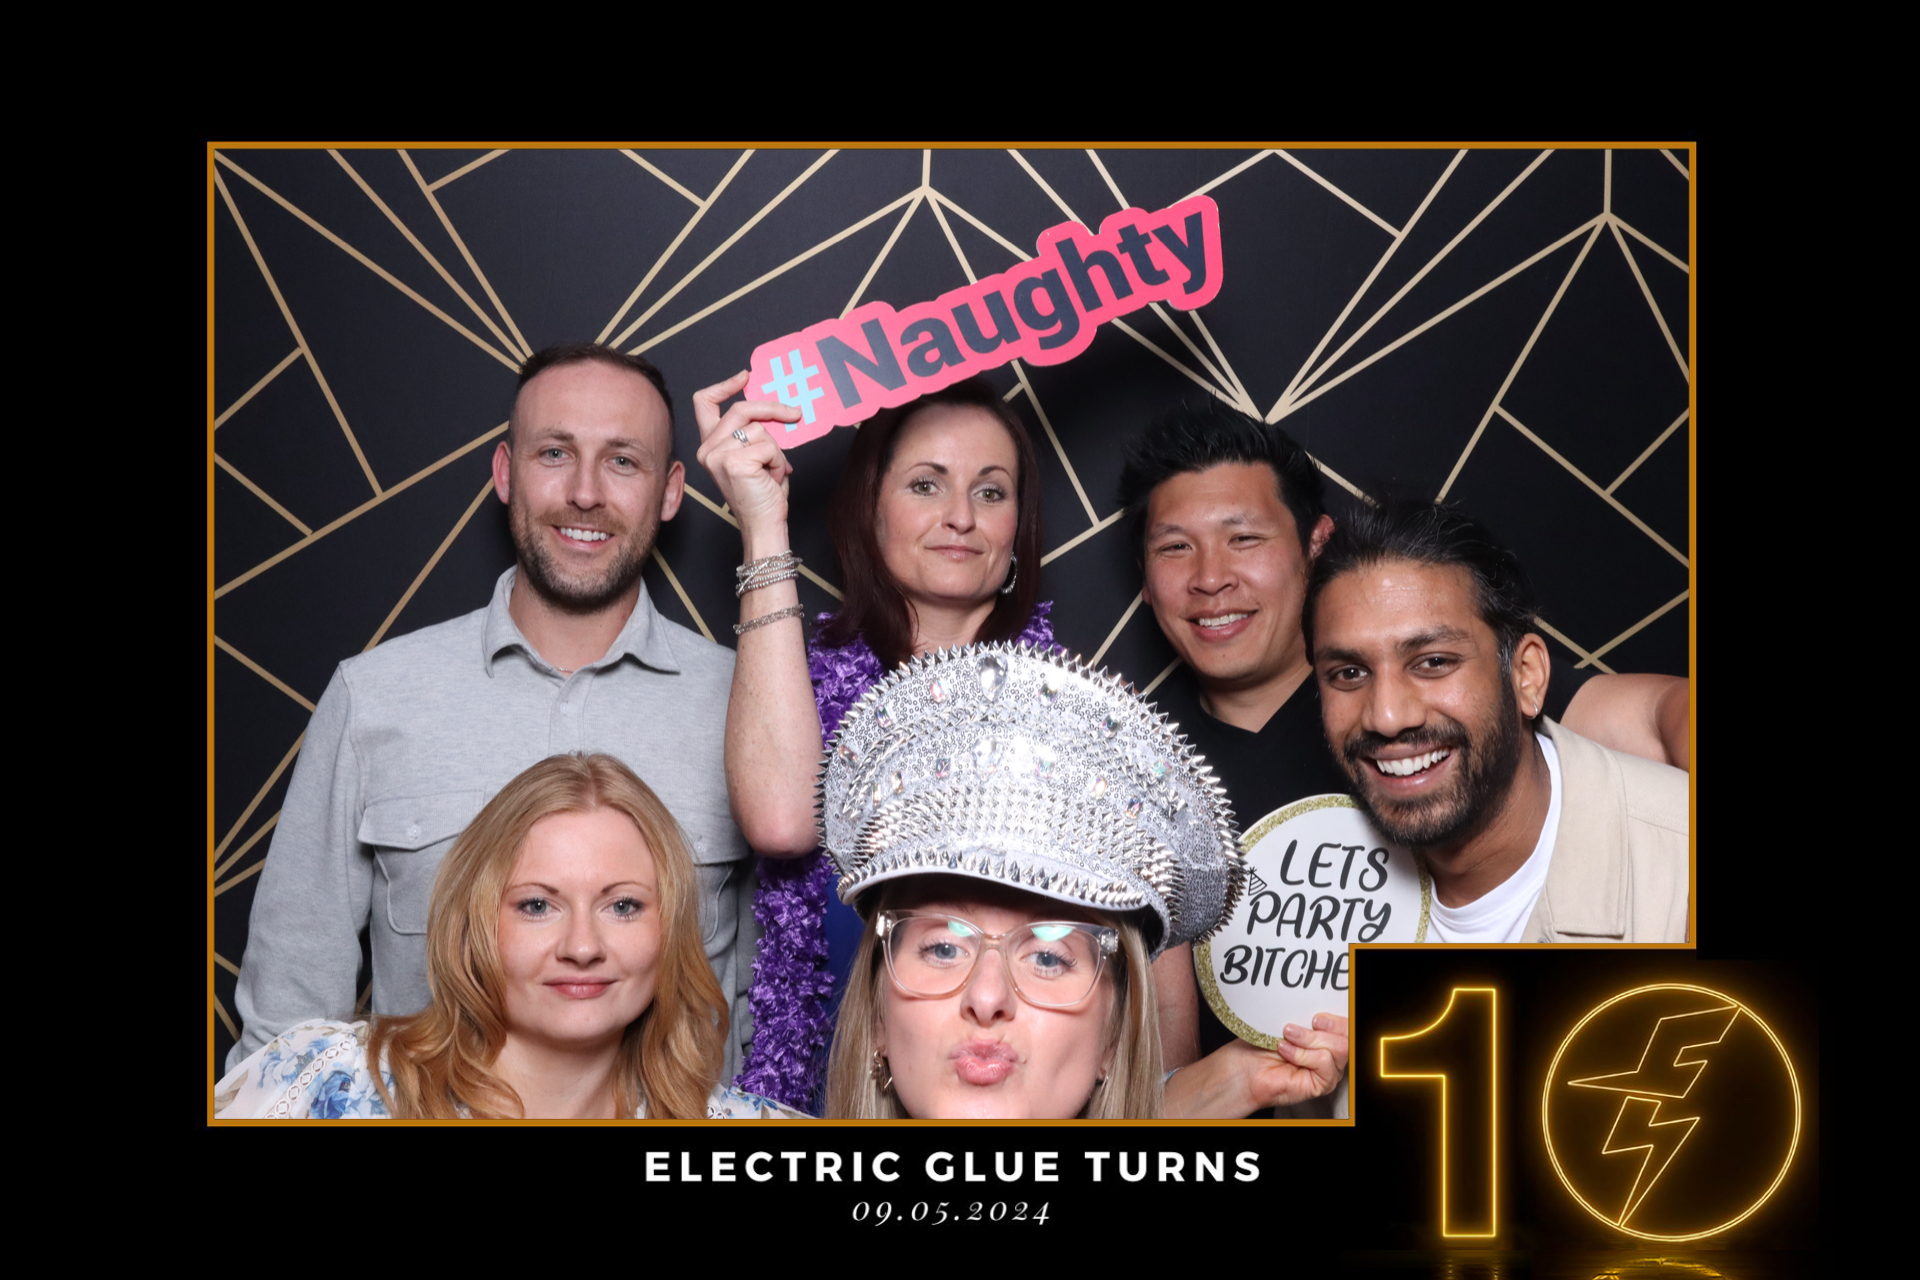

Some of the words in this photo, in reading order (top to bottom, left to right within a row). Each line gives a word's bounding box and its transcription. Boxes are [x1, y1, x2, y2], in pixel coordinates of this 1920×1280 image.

[761, 211, 1207, 433] #Naughty
[1280, 839, 1390, 892] LETS
[1247, 890, 1392, 943] PARTY
